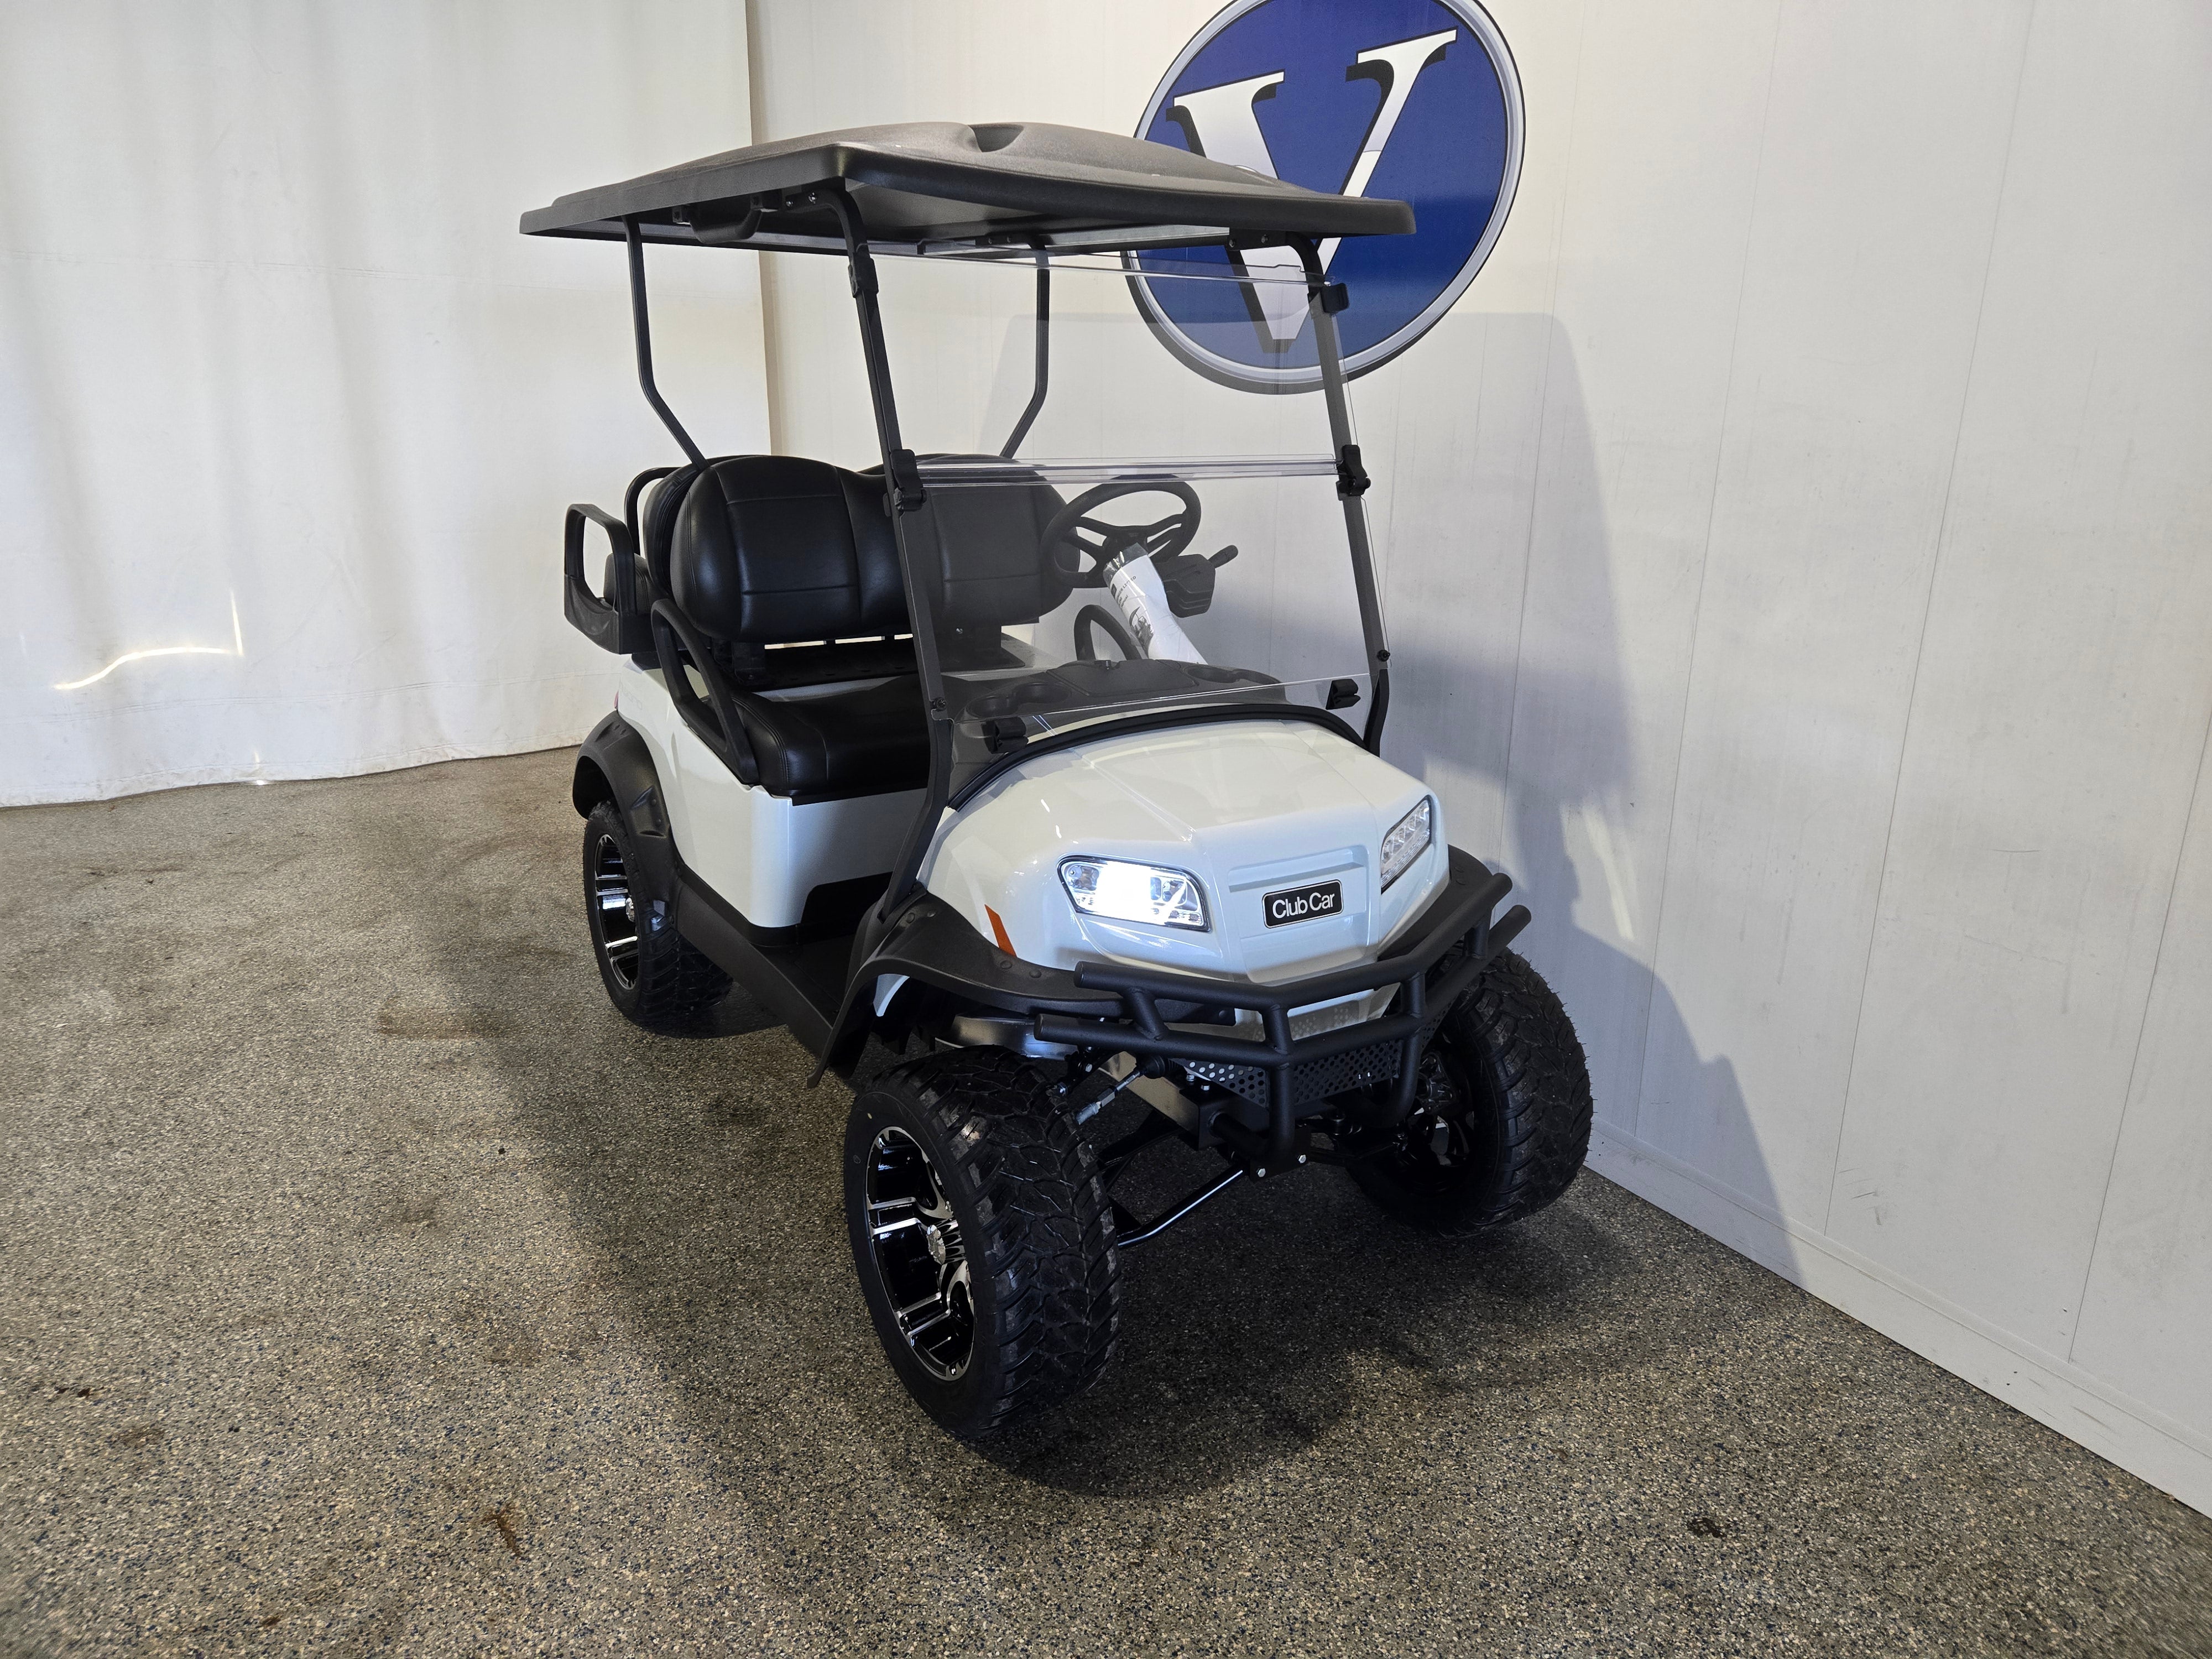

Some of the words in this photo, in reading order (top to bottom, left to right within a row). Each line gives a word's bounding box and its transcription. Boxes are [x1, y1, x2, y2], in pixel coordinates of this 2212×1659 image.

[1171, 27, 1458, 341] V
[1272, 896, 1308, 919] Club
[1309, 892, 1335, 911] Car
